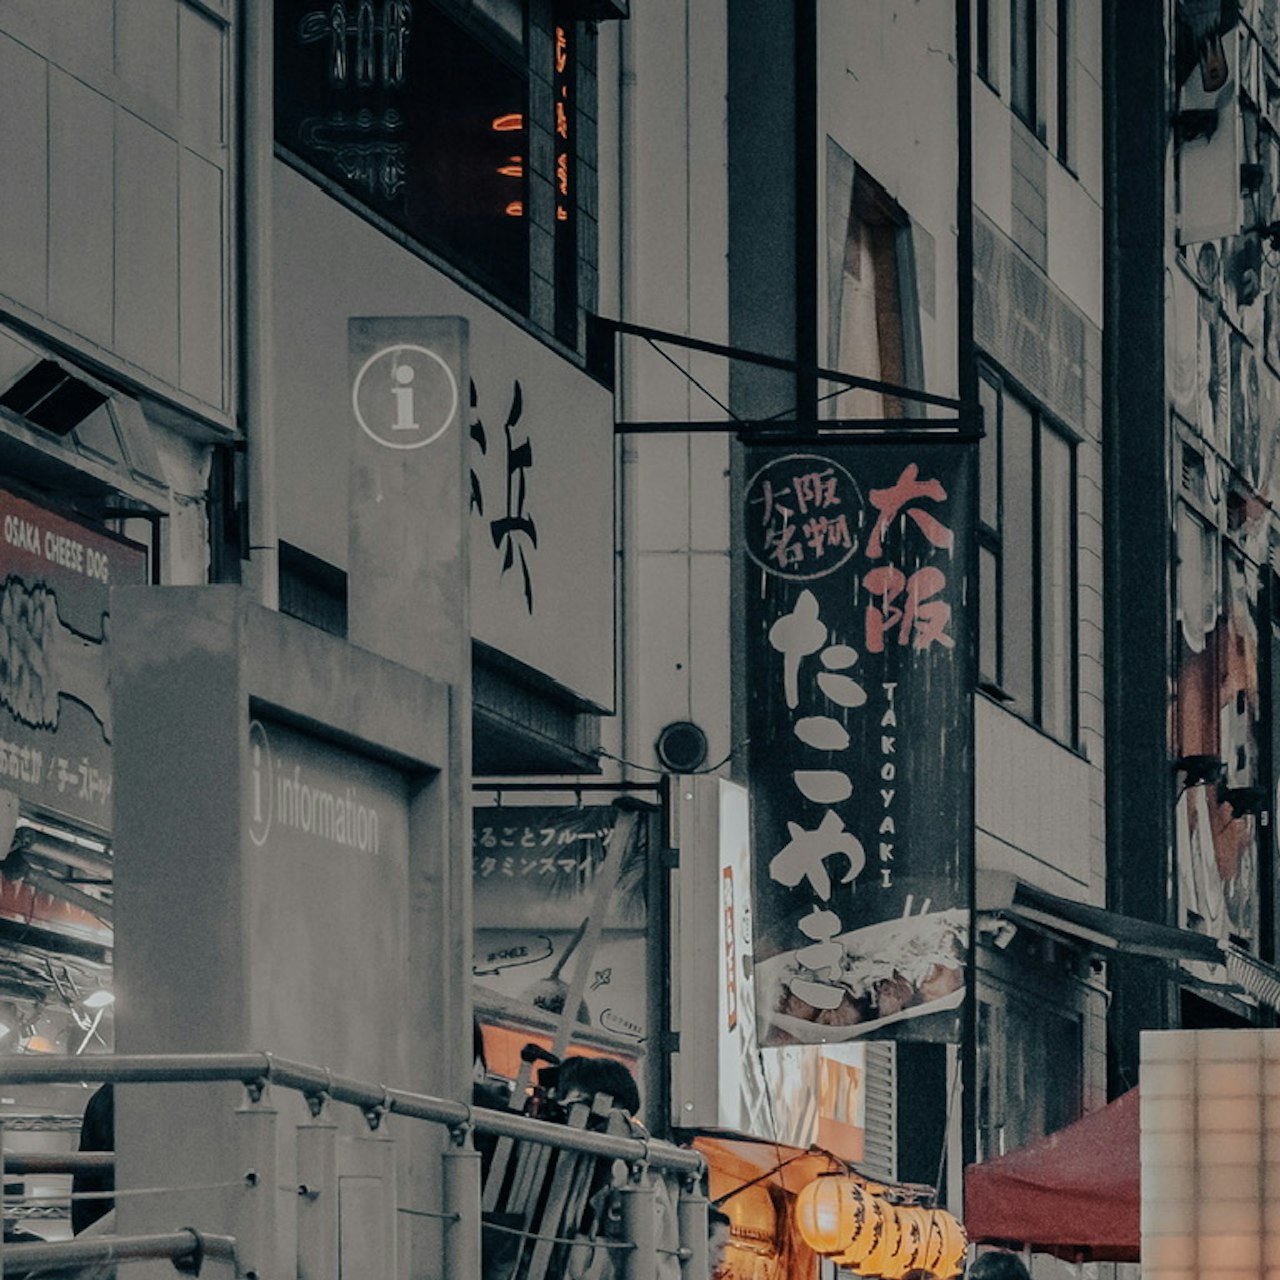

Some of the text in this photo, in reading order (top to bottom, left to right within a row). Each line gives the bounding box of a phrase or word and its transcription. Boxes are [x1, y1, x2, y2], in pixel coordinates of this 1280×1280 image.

[4, 514, 110, 586] OSAKA CHEESE DOG
[863, 462, 955, 654] 大阪
[276, 758, 380, 856] information
[768, 588, 869, 1011] たこやき
[878, 681, 899, 889] TAKOYAKI
[472, 826, 615, 849] るごとフルーツ
[472, 856, 603, 878] タミンスマイ
